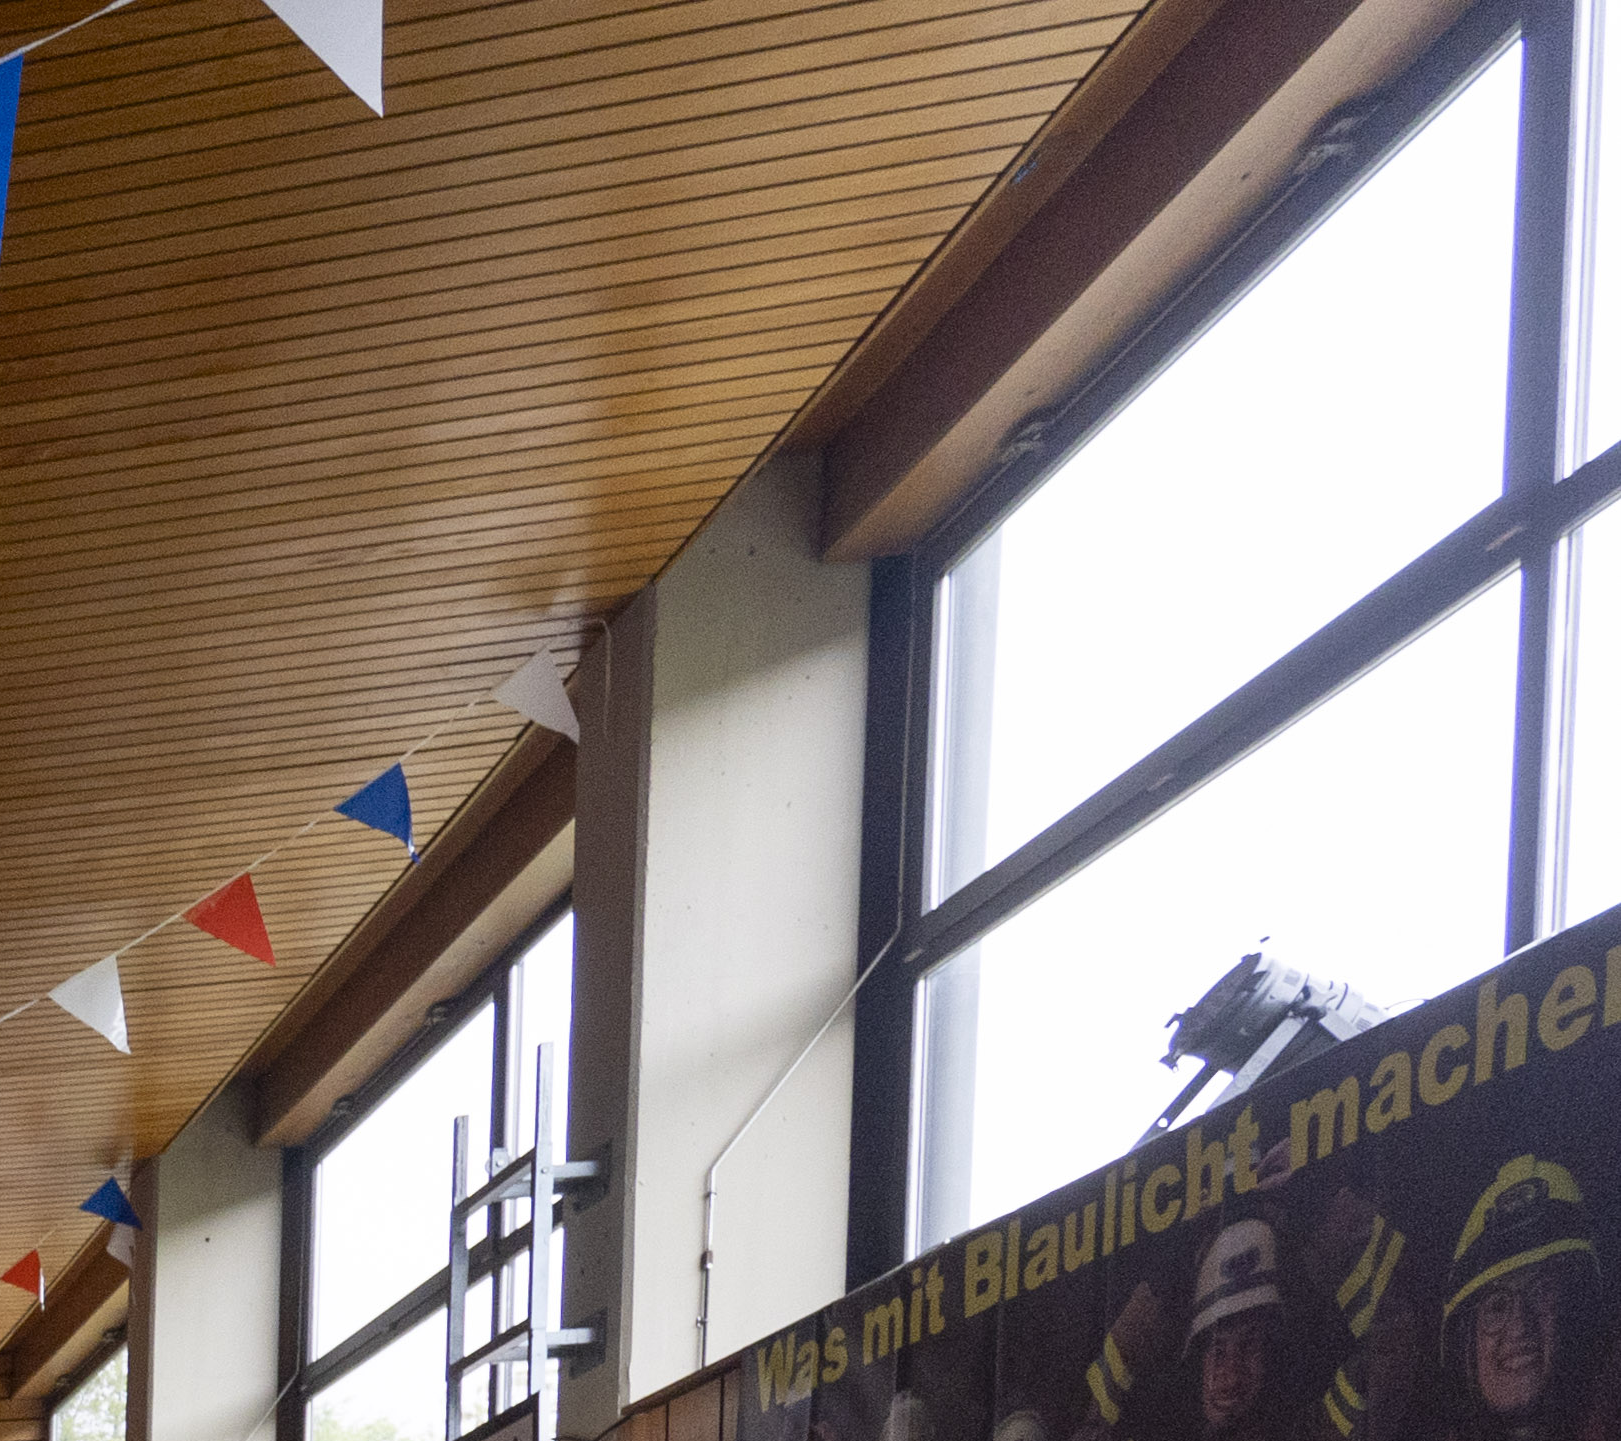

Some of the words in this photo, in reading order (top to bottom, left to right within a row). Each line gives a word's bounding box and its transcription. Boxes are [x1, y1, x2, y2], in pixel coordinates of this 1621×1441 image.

[757, 1325, 849, 1414] Was
[862, 1261, 947, 1365] mit
[963, 1104, 1260, 1320] Blaulicht
